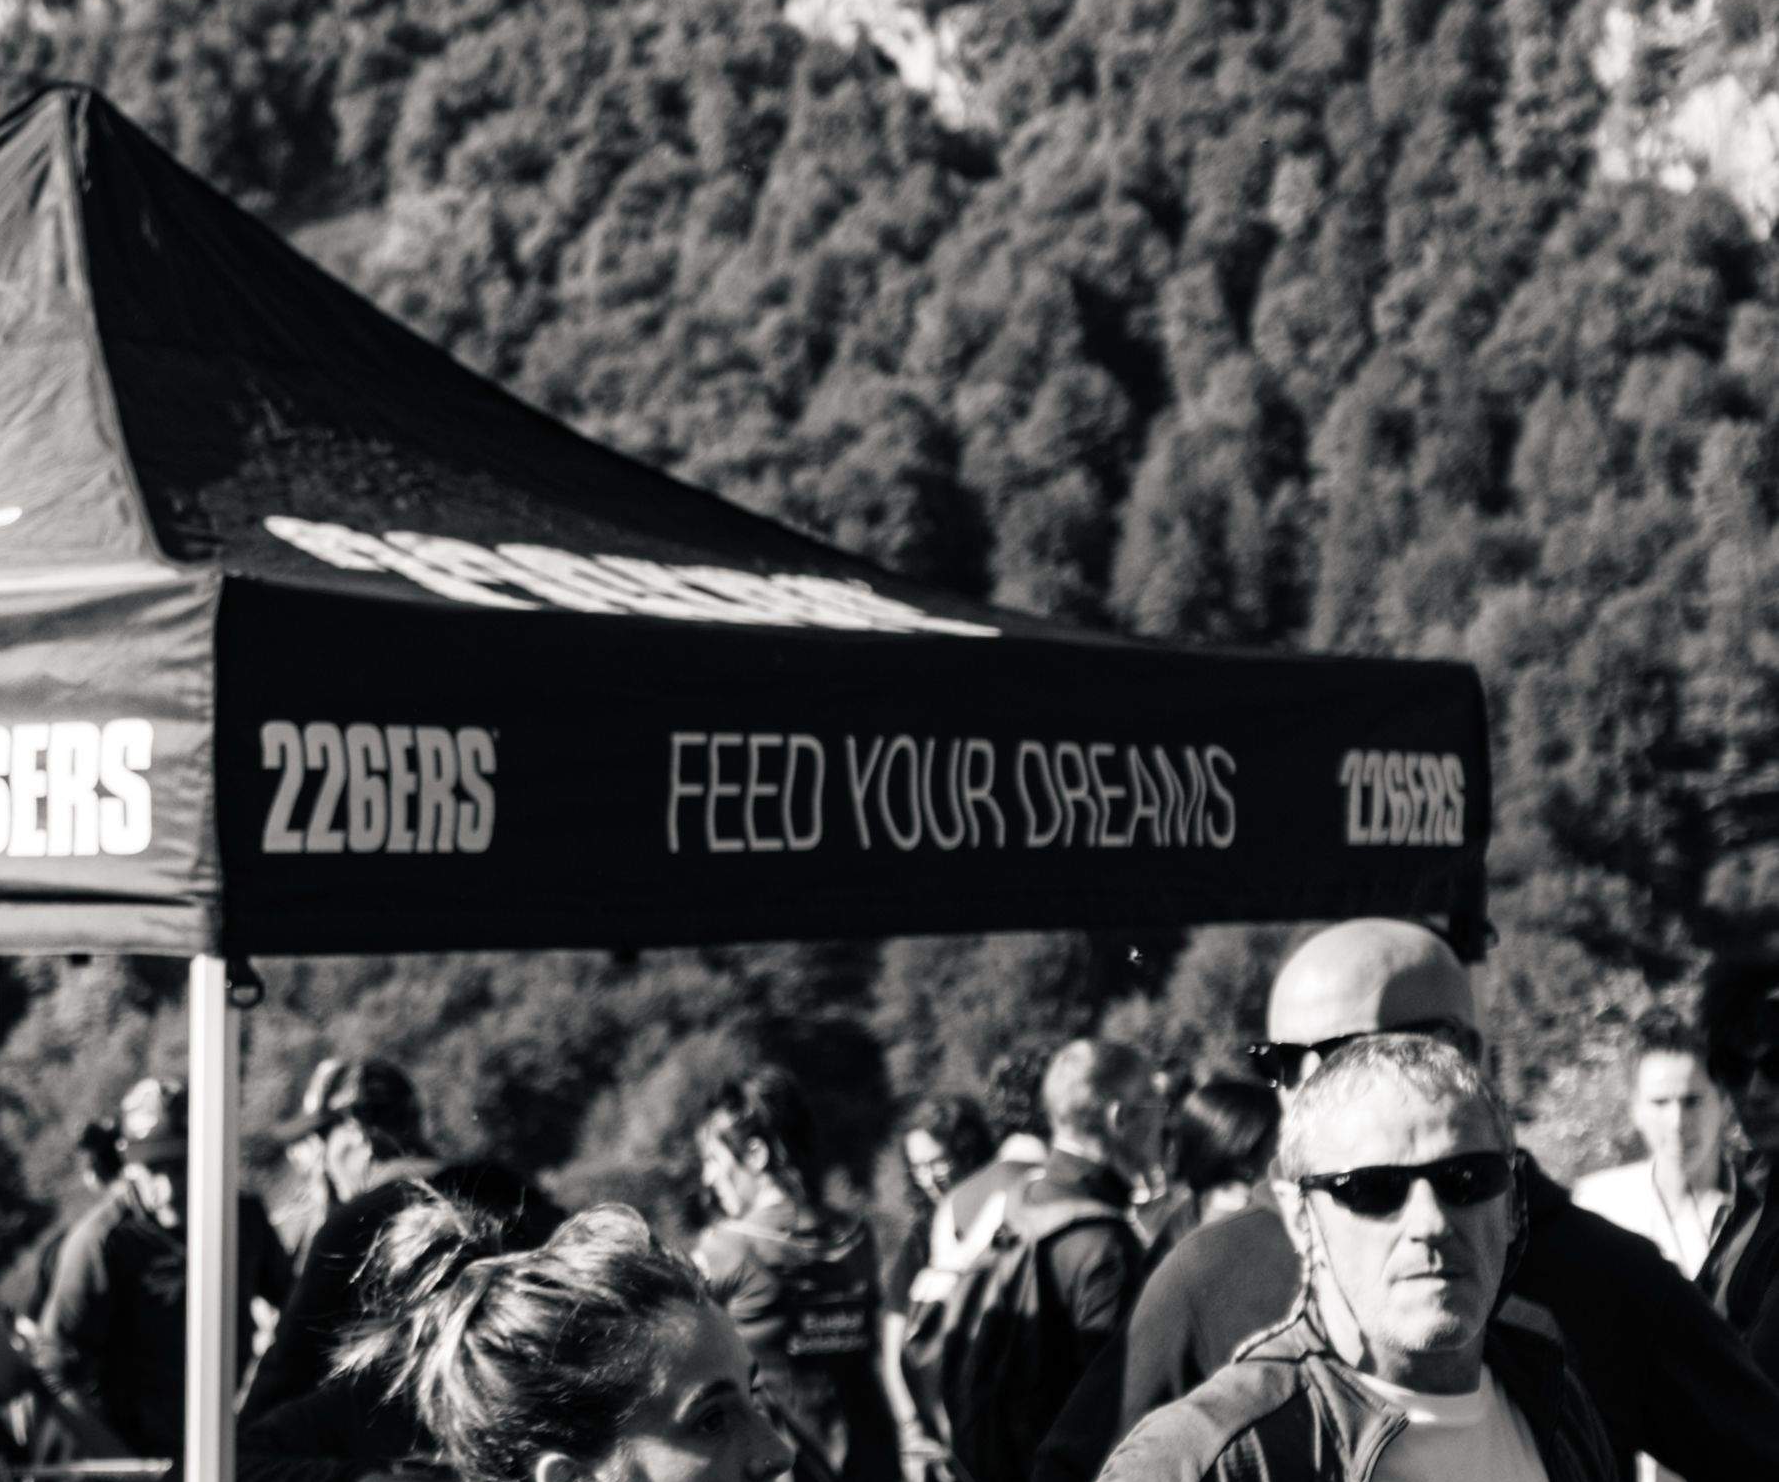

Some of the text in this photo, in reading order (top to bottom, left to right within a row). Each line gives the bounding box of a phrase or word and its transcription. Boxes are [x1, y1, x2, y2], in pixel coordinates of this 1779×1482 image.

[260, 720, 496, 854] 226ERS
[667, 731, 1238, 853] FEED YOUR DREAMS
[1338, 747, 1466, 848] 226ERS
